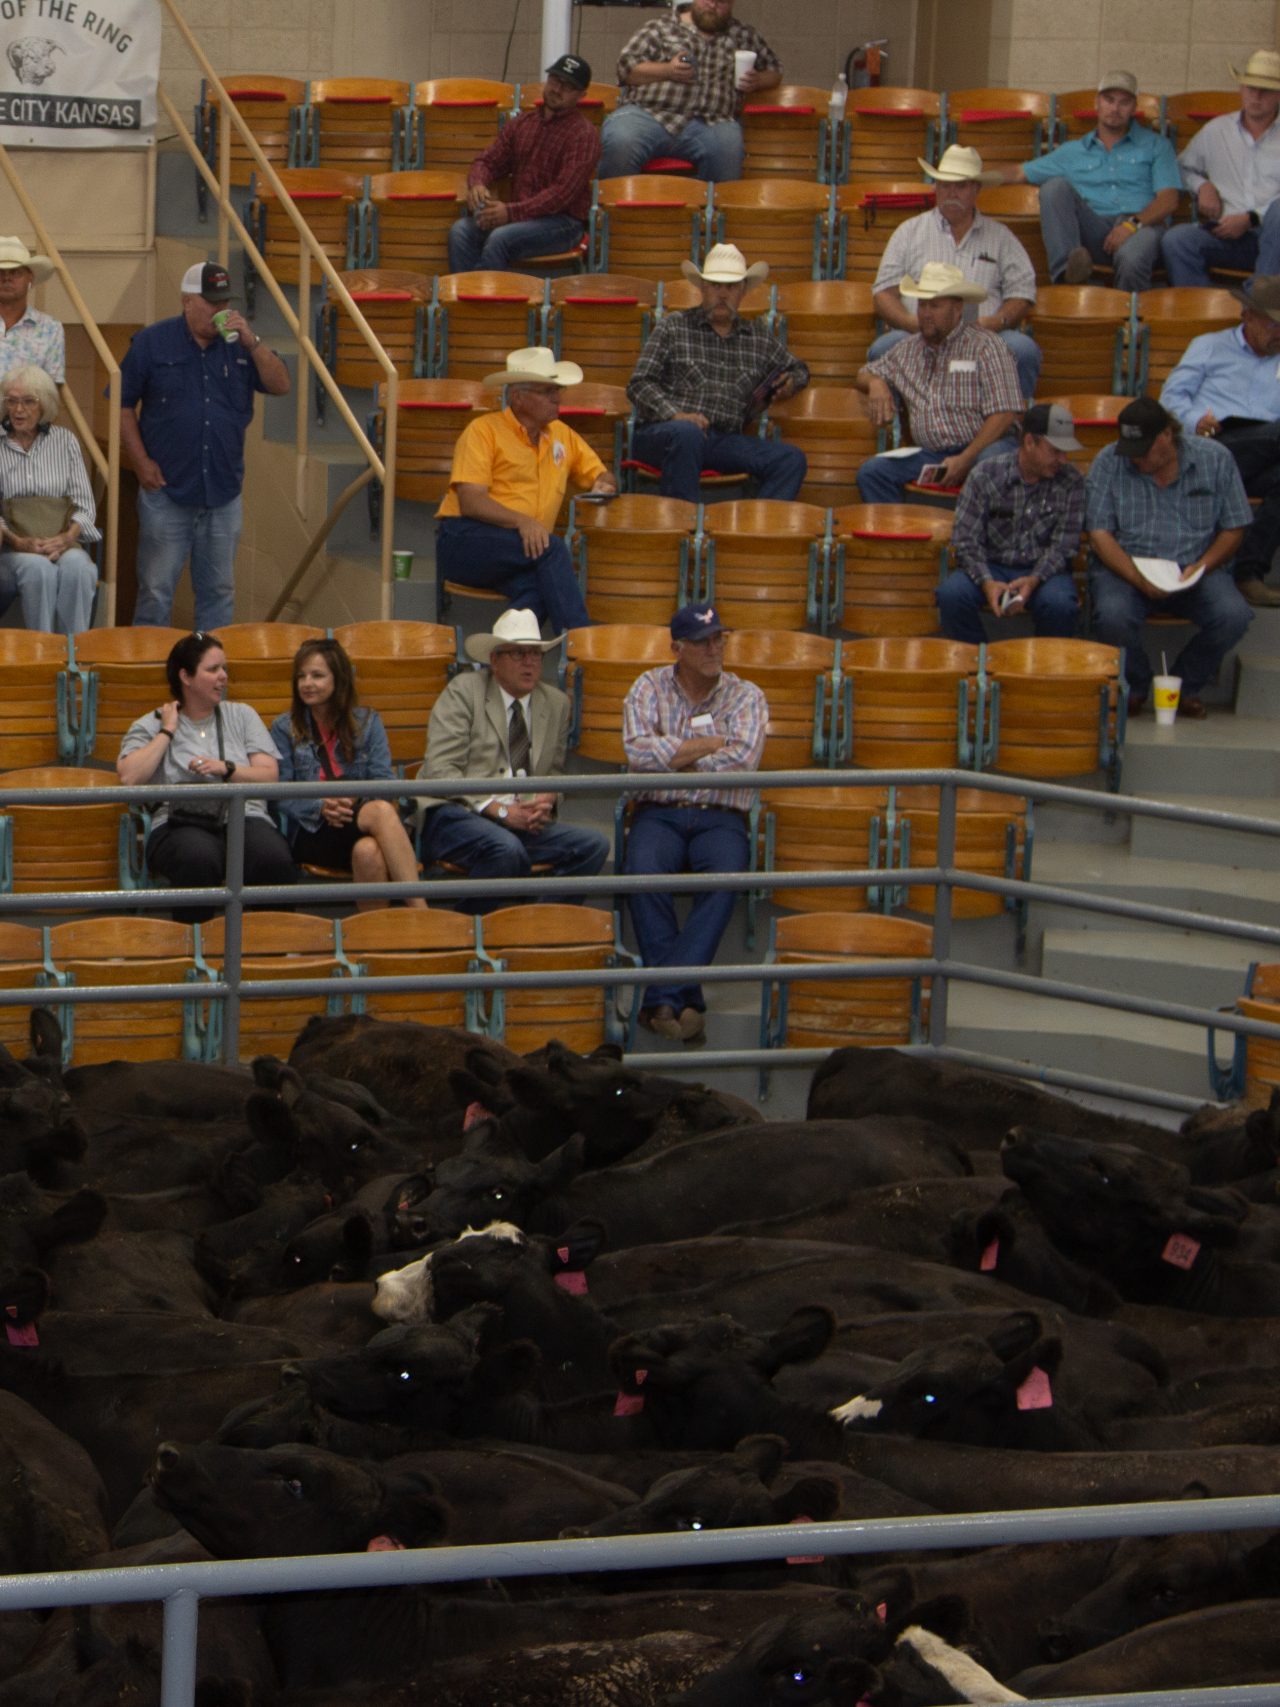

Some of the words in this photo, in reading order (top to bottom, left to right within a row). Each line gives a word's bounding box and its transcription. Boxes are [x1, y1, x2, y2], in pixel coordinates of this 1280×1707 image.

[1, 0, 27, 20] OF
[35, 0, 78, 24] THE
[82, 10, 133, 53] RING
[10, 98, 51, 122] CITY
[55, 101, 135, 127] KANSAS
